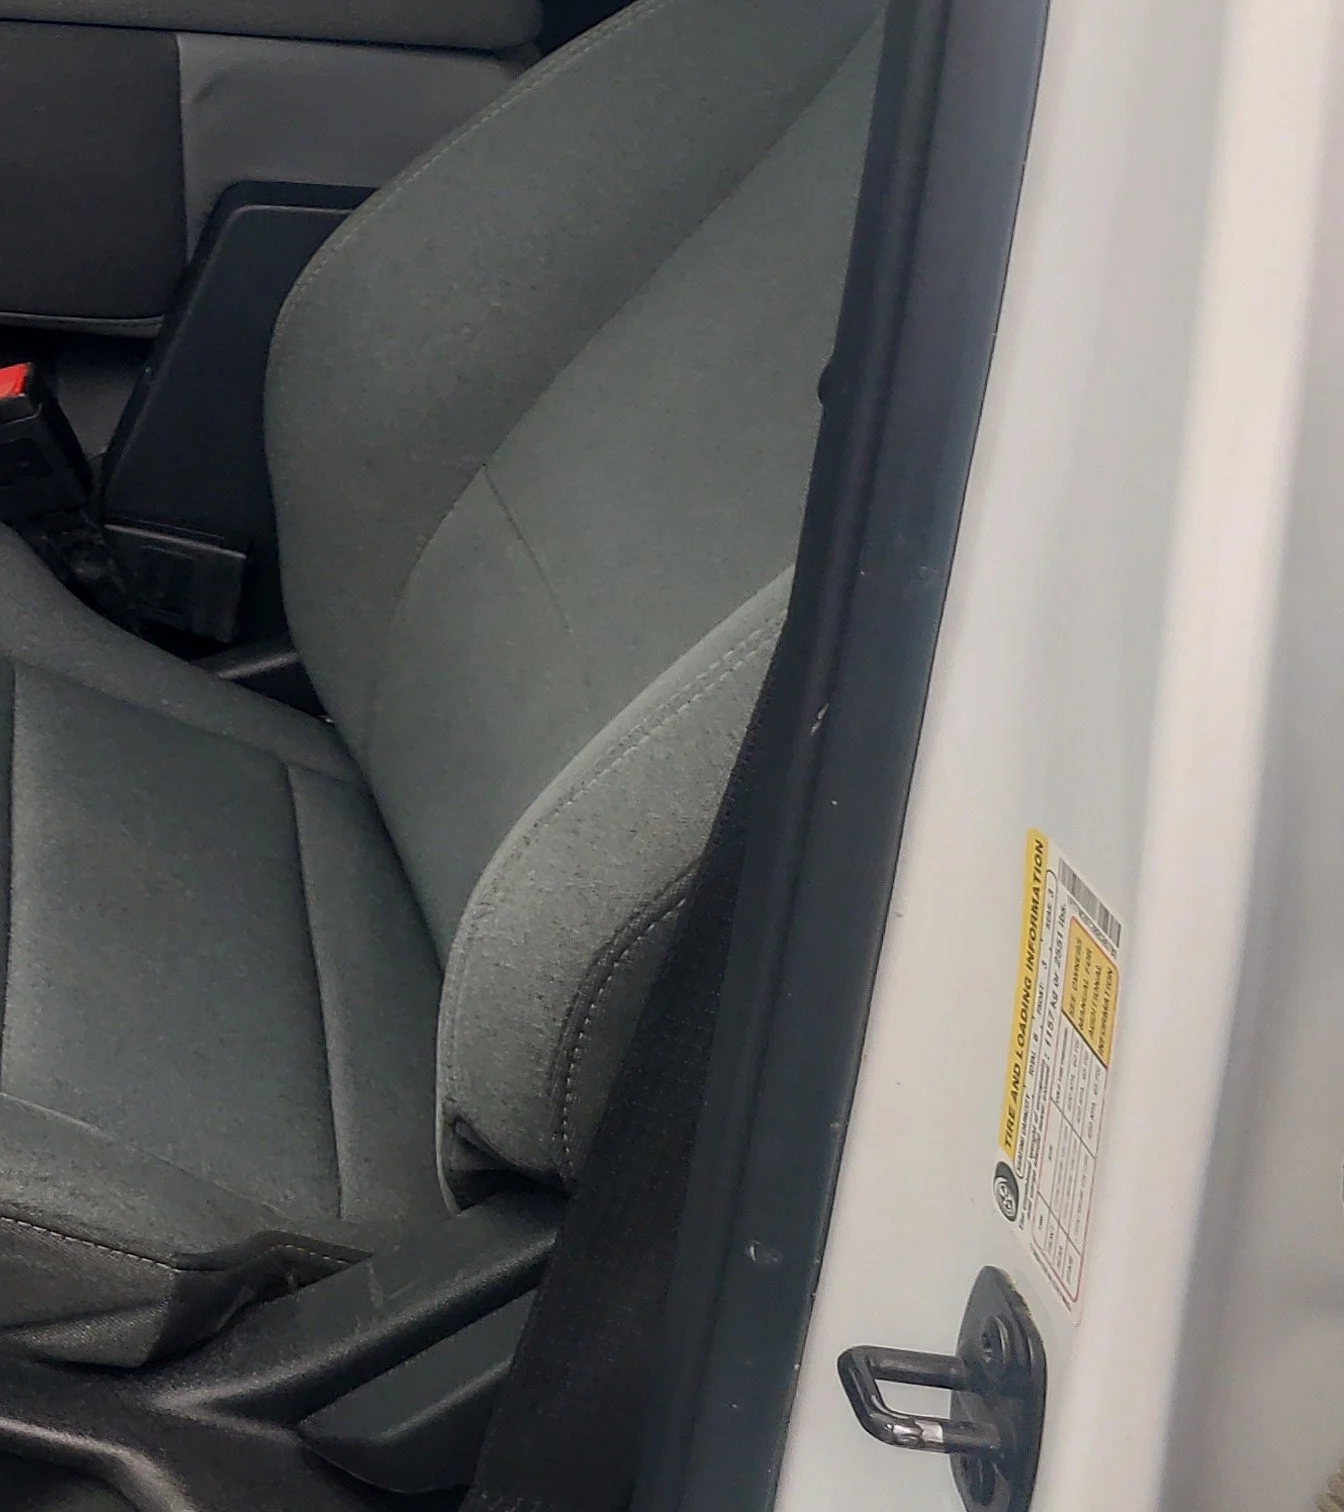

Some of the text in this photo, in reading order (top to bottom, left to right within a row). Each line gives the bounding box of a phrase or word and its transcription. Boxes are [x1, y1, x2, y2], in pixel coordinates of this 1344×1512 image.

[1004, 839, 1044, 1148] TIRE AND LOADING INFORMATION
